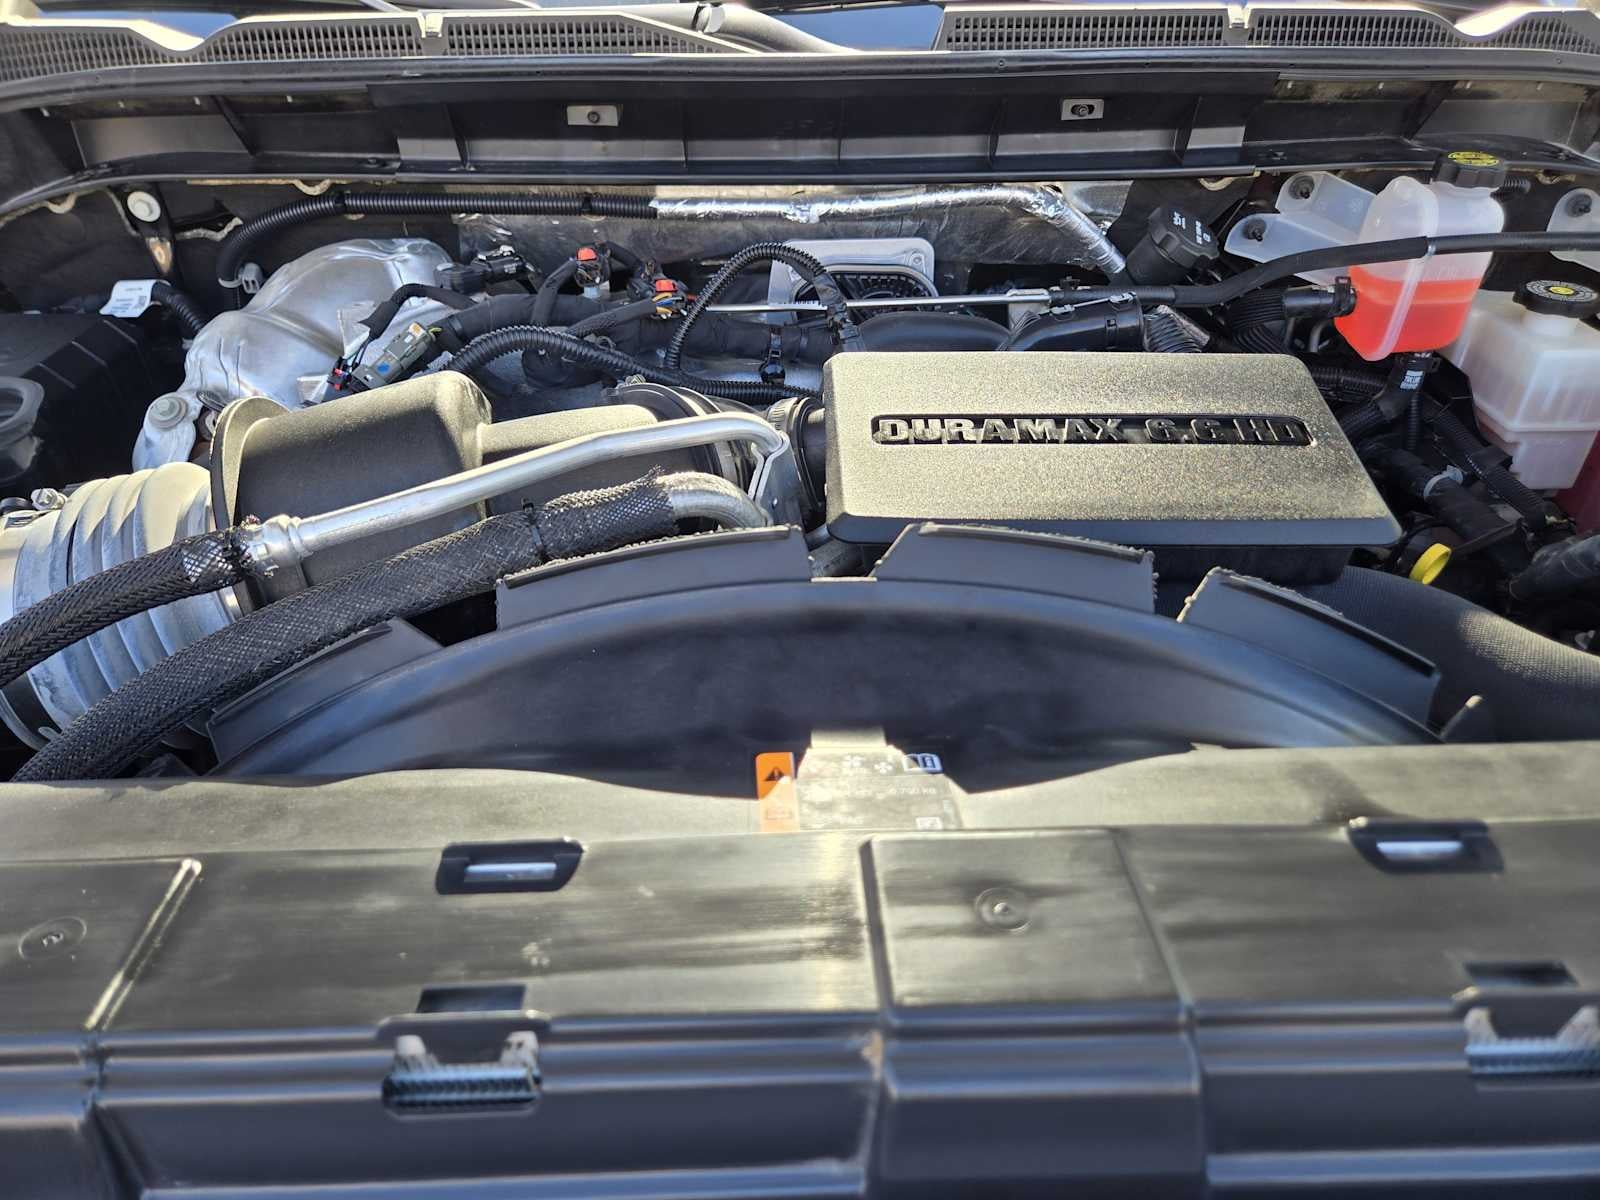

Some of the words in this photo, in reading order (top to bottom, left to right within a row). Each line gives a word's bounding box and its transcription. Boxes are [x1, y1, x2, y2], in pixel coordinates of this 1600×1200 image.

[878, 418, 1124, 442] DURAMAX
[1144, 418, 1223, 442] 6.6
[1232, 418, 1304, 443] HD
